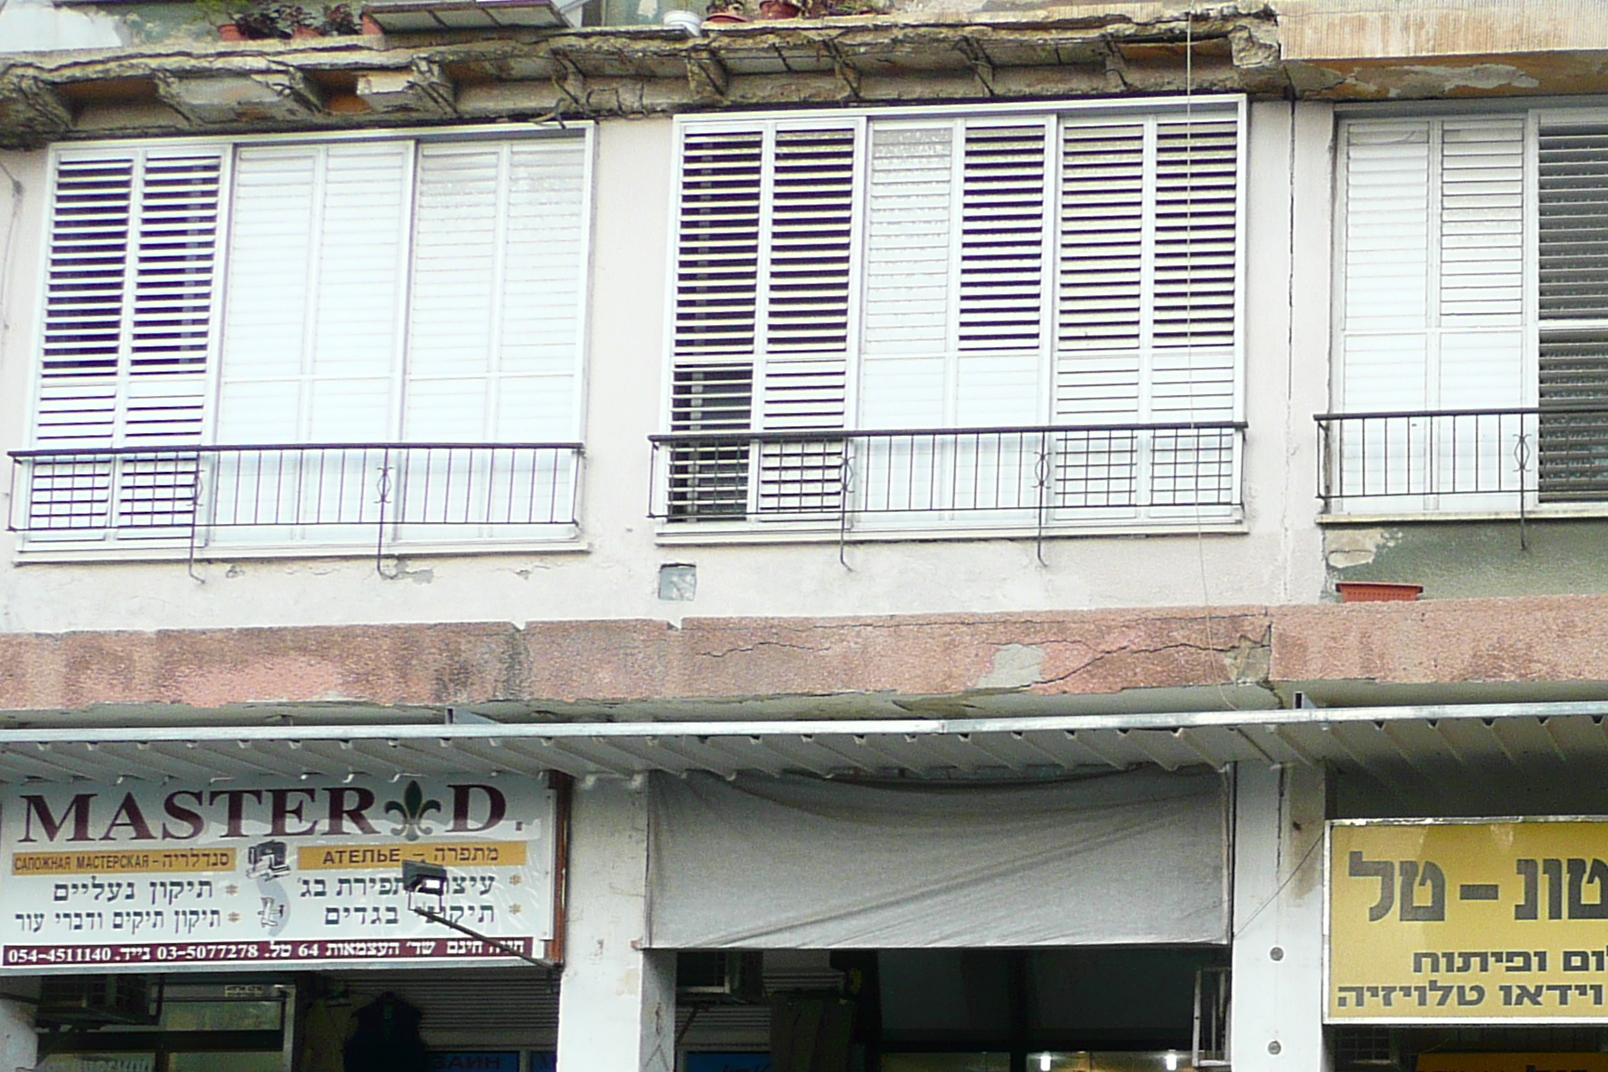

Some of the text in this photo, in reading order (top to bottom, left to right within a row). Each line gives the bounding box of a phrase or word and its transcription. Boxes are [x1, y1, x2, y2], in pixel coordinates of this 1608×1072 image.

[19, 786, 381, 842] MASTER
[77, 854, 149, 870] МАСТЕРСКАЯ
[162, 848, 229, 868] סנדלריה
[434, 846, 499, 862] מתפרה
[53, 875, 213, 906] תיקון נעליים
[433, 875, 496, 897] עיצו
[14, 907, 222, 935] תיקון תיקים ודברי עור
[324, 904, 400, 926] בגדים
[8, 948, 111, 963] 054-4511140
[157, 945, 259, 960] 03-5077278
[298, 943, 319, 957] 64
[326, 941, 400, 957] העצמאות
[446, 940, 484, 955] חינם
[1412, 948, 1550, 974] ופיתוח
[1336, 979, 1487, 1008] טלויזיה
[1499, 983, 1605, 1007] וידאו
